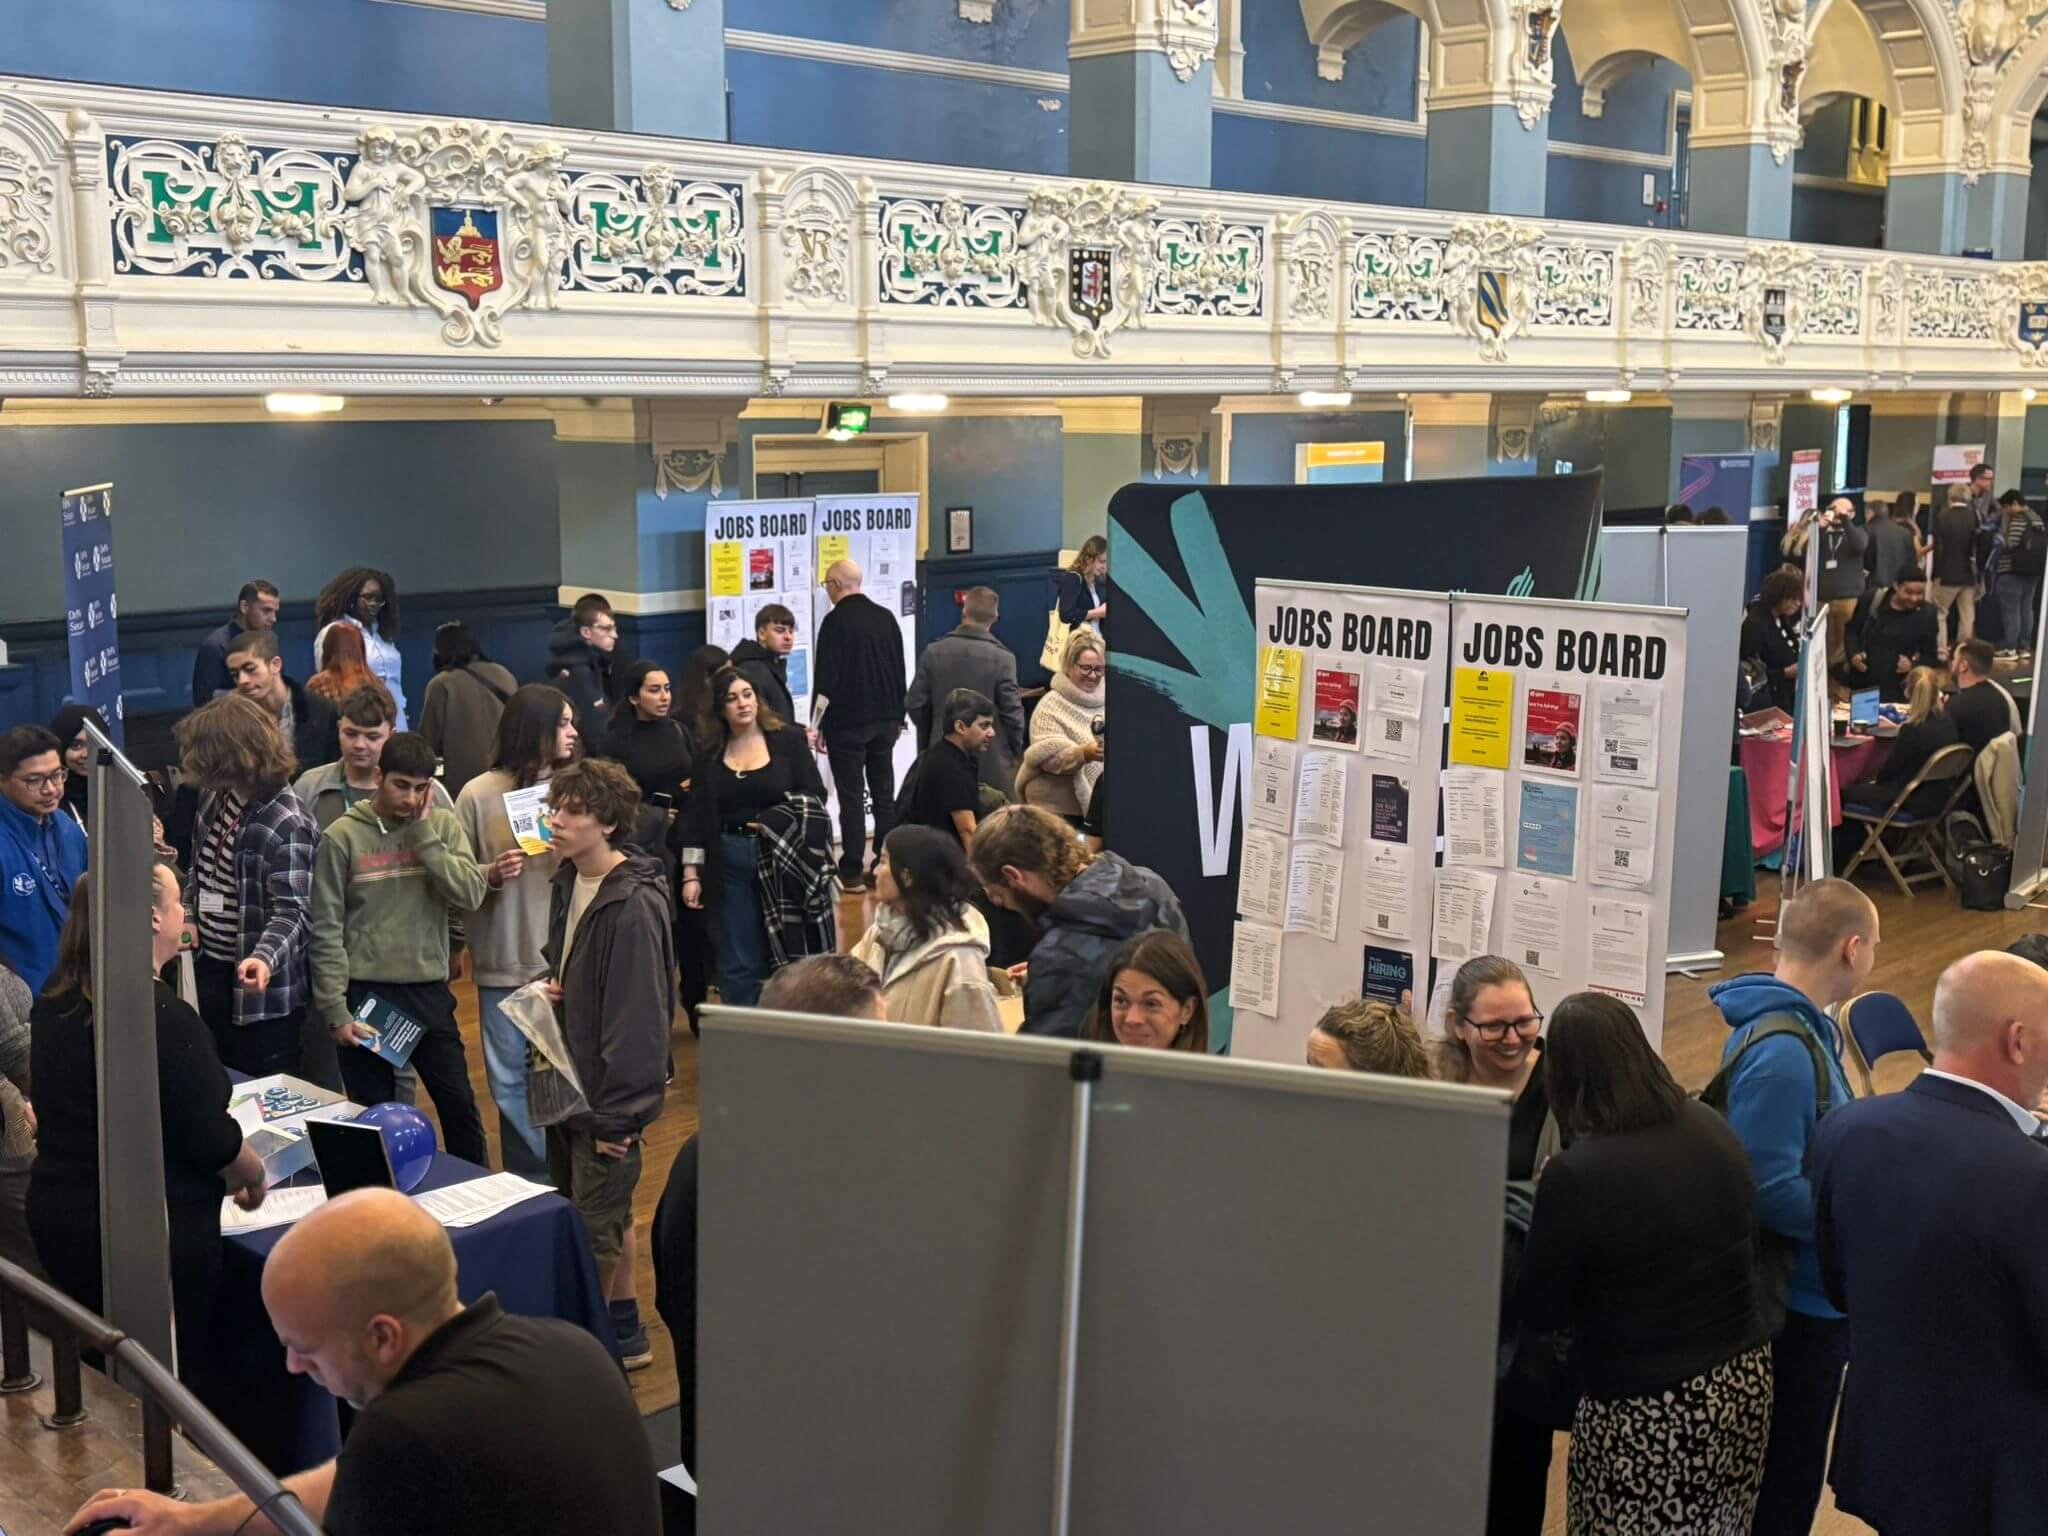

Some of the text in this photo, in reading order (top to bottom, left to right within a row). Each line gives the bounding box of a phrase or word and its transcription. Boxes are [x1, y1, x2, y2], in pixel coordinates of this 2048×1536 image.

[715, 513, 807, 540] JOBS BOARD
[822, 507, 912, 532] JOBS BOARD
[1268, 605, 1432, 661] JOBS BOARD
[1463, 622, 1667, 680] JOBS BOARD
[1367, 960, 1408, 979] HIRING
